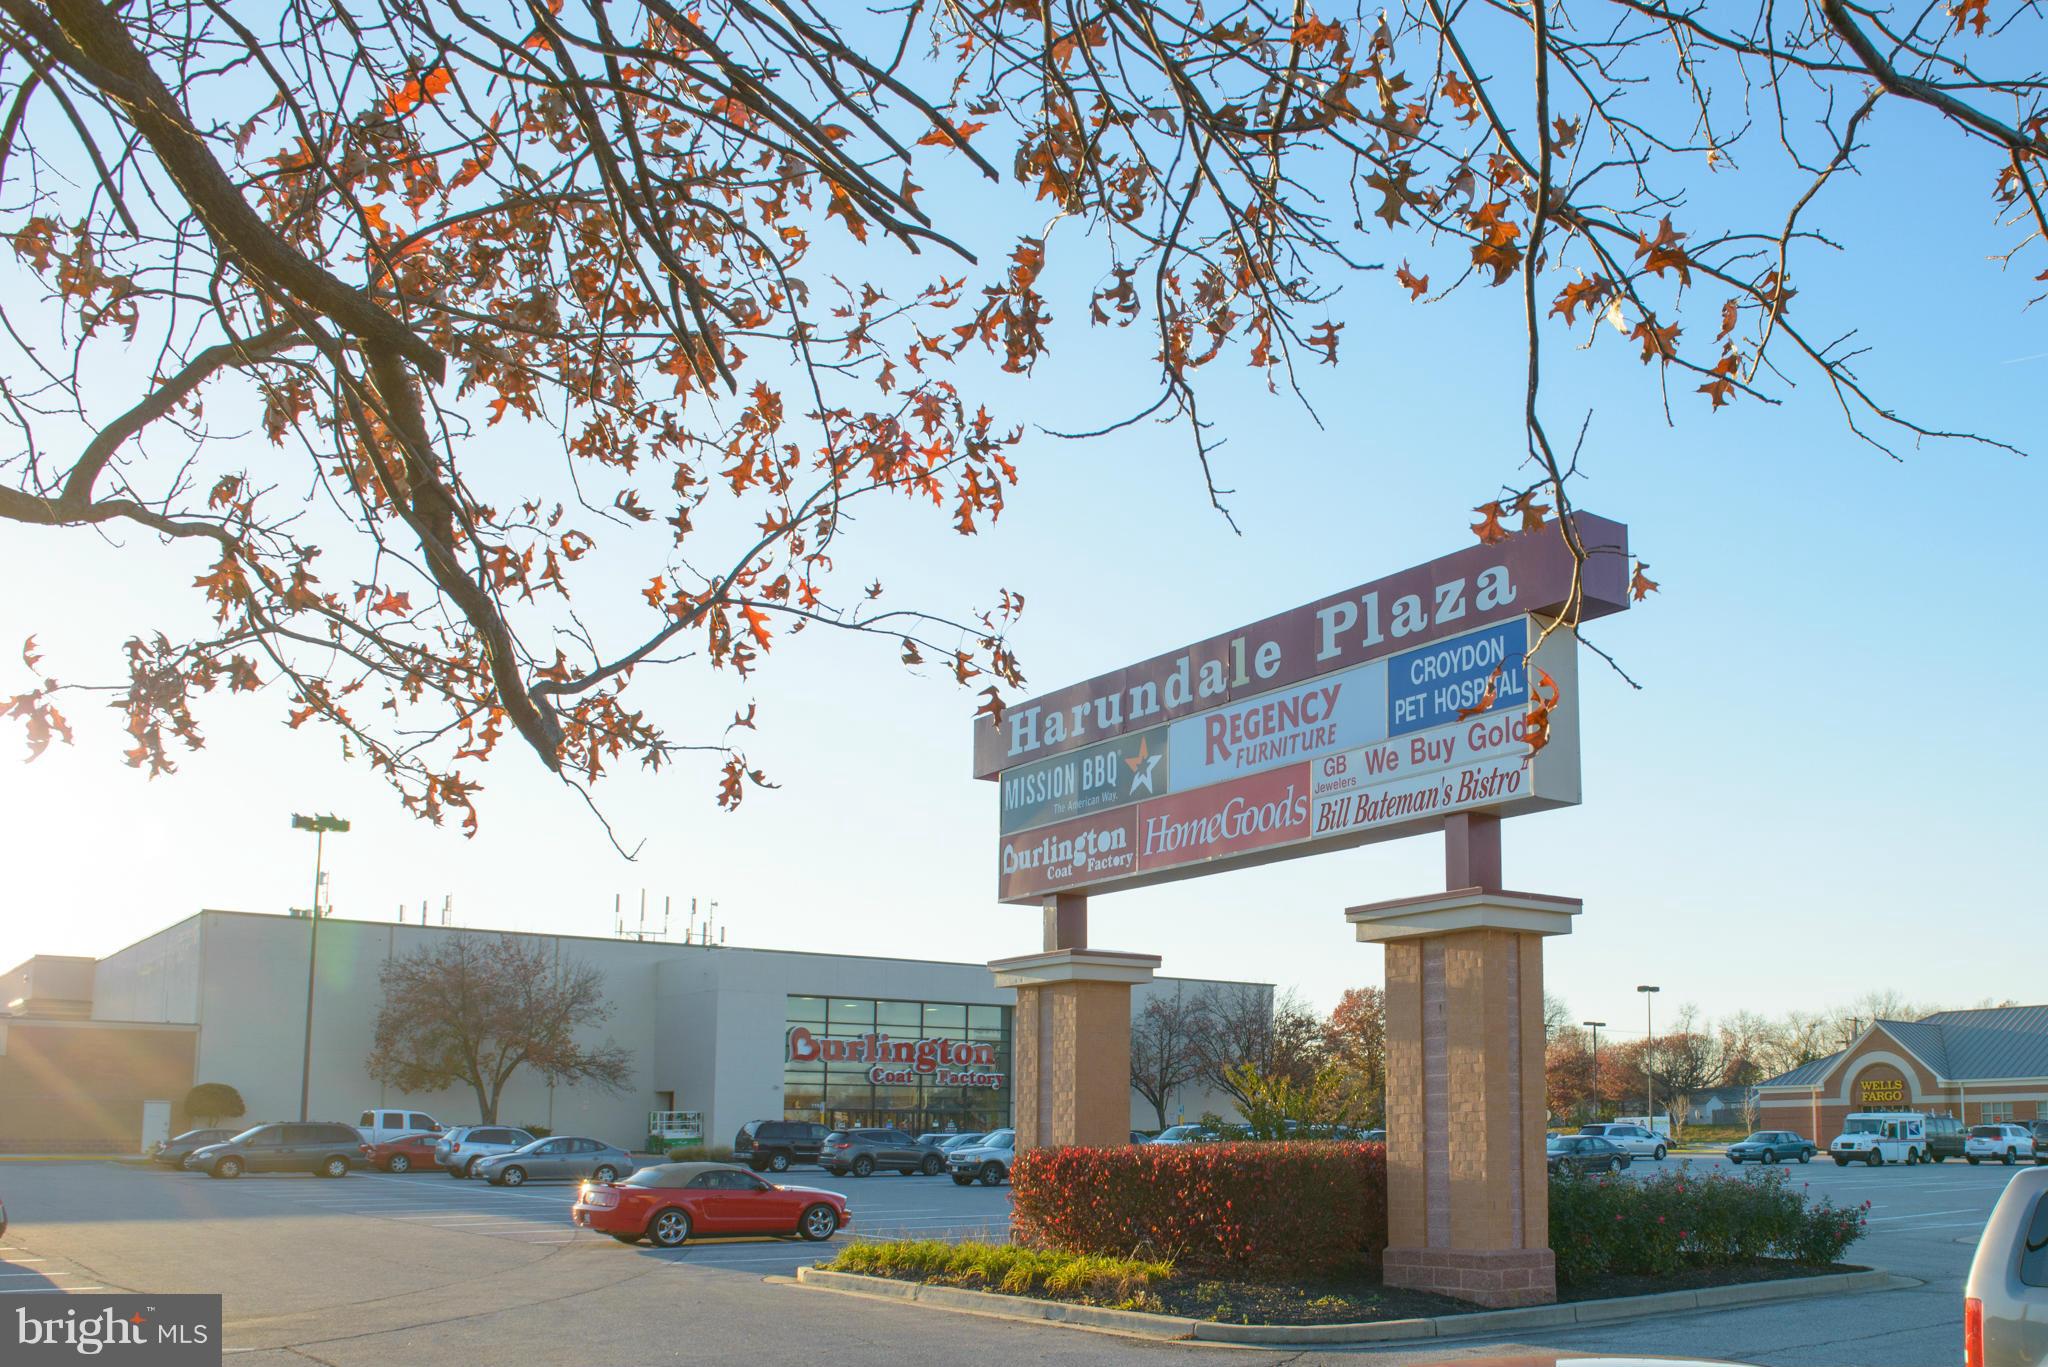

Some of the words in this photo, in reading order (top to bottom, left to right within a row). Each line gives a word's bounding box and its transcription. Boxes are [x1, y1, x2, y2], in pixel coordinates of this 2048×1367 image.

[1007, 636, 1282, 757] Harundale
[1316, 564, 1517, 662] Plaza
[1411, 635, 1504, 685] CROYDON
[1205, 683, 1342, 766] REGENCY
[1395, 693, 1427, 724] PET
[1236, 723, 1336, 768] FURNITURE
[1323, 755, 1347, 777] GB
[1365, 746, 1399, 775] We
[1410, 736, 1456, 765] Buy
[1468, 712, 1527, 751] Gold
[1005, 763, 1074, 811] MISSION
[1083, 751, 1117, 791] BBQ
[1315, 776, 1357, 794] Jewelers
[1316, 796, 1352, 833] Bill
[1353, 776, 1453, 825] Bateman's
[1456, 767, 1520, 803] Bistro
[1054, 803, 1066, 815] The
[1068, 795, 1100, 811] American
[1143, 784, 1308, 856] HomeGoods
[1003, 827, 1126, 874] Burlington
[1047, 864, 1073, 880] Coat
[1087, 852, 1134, 872] Factory
[790, 1026, 997, 1074] Burlington
[870, 1066, 913, 1085] Coat
[936, 1067, 1004, 1089] Factory
[1860, 1080, 1903, 1091] WELLS
[1862, 1090, 1903, 1102] FARGO
